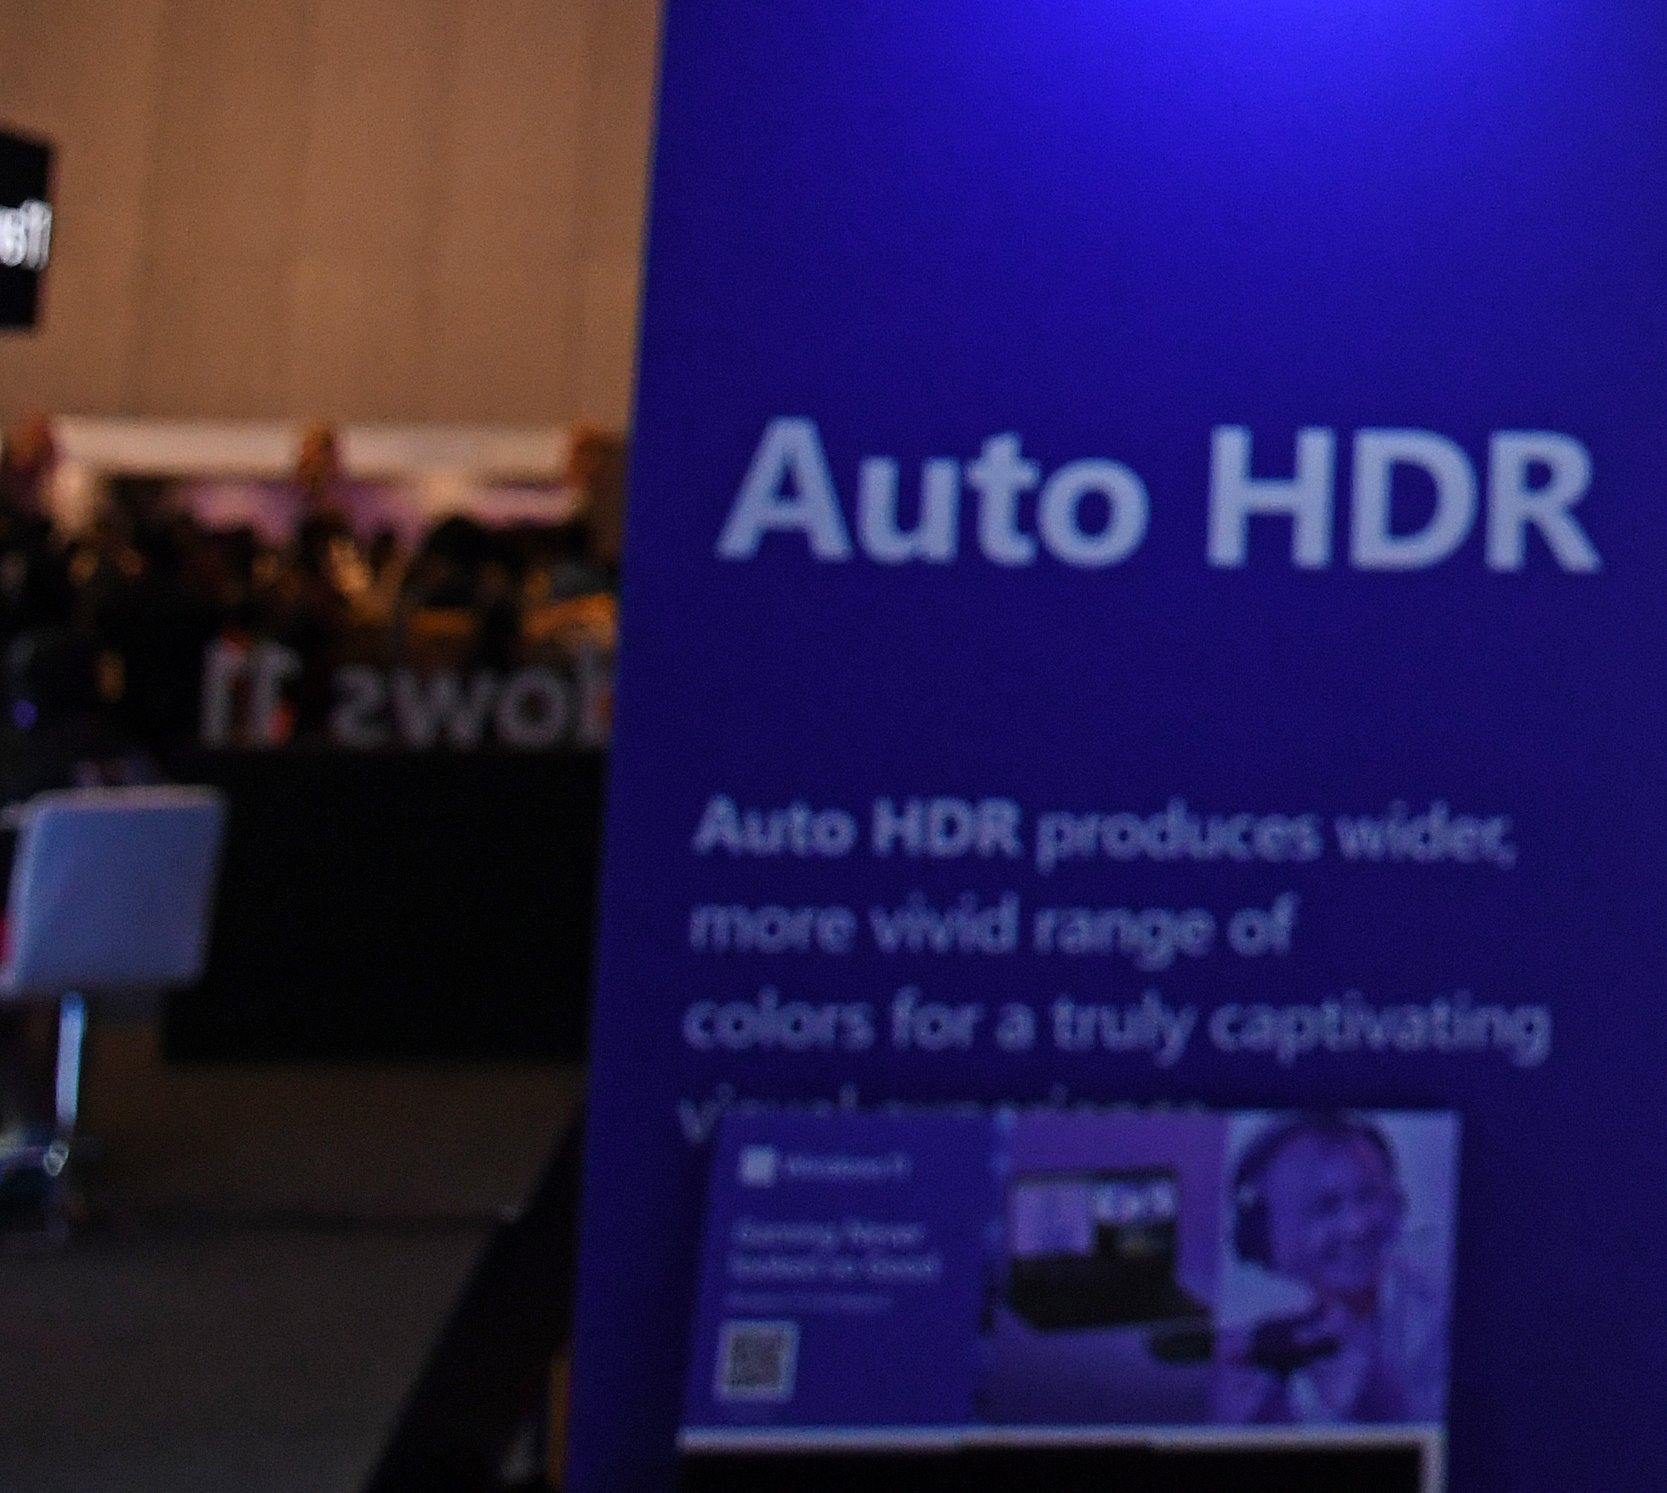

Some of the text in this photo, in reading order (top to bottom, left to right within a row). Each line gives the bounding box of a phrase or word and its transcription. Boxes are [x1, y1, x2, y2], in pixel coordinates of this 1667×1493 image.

[720, 417, 1597, 572] Auto HDR
[692, 794, 1518, 872] Auto HDR produces wider,
[689, 891, 1302, 970] more vivid range of
[682, 987, 1555, 1068] colors for a truly captivating
